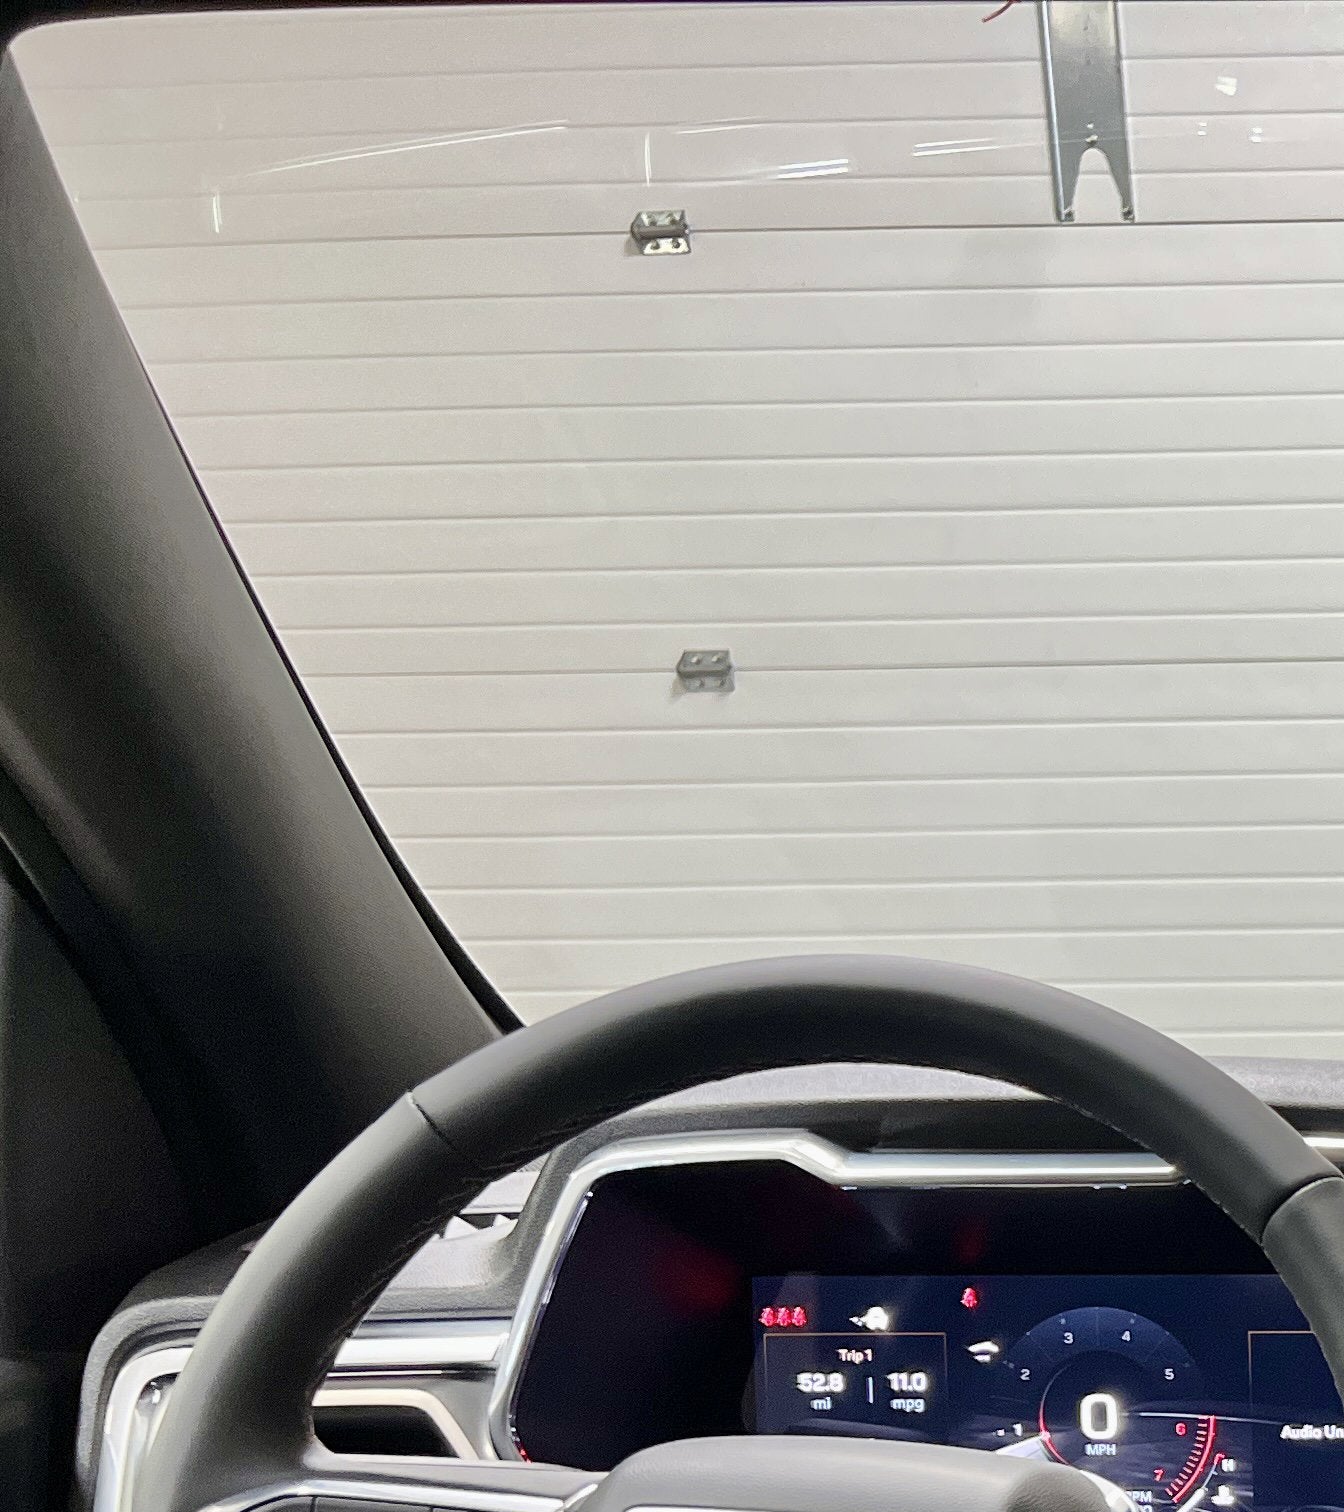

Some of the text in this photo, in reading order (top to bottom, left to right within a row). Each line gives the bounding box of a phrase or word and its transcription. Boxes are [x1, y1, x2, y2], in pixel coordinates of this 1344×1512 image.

[1063, 1332, 1074, 1345] 3
[1121, 1330, 1131, 1342] 4
[836, 1349, 872, 1364] Trip 1
[1020, 1369, 1031, 1381] 2
[1165, 1368, 1174, 1380] 5
[796, 1372, 844, 1392] 52.8
[886, 1372, 927, 1392] 11.0
[810, 1397, 833, 1411] mi
[890, 1398, 926, 1413] mpg
[1079, 1392, 1118, 1440] 0
[1013, 1423, 1023, 1436] 1
[1176, 1422, 1187, 1436] 6
[1280, 1425, 1322, 1440] Audio
[1085, 1443, 1117, 1456] MPH
[1153, 1469, 1164, 1482] 7
